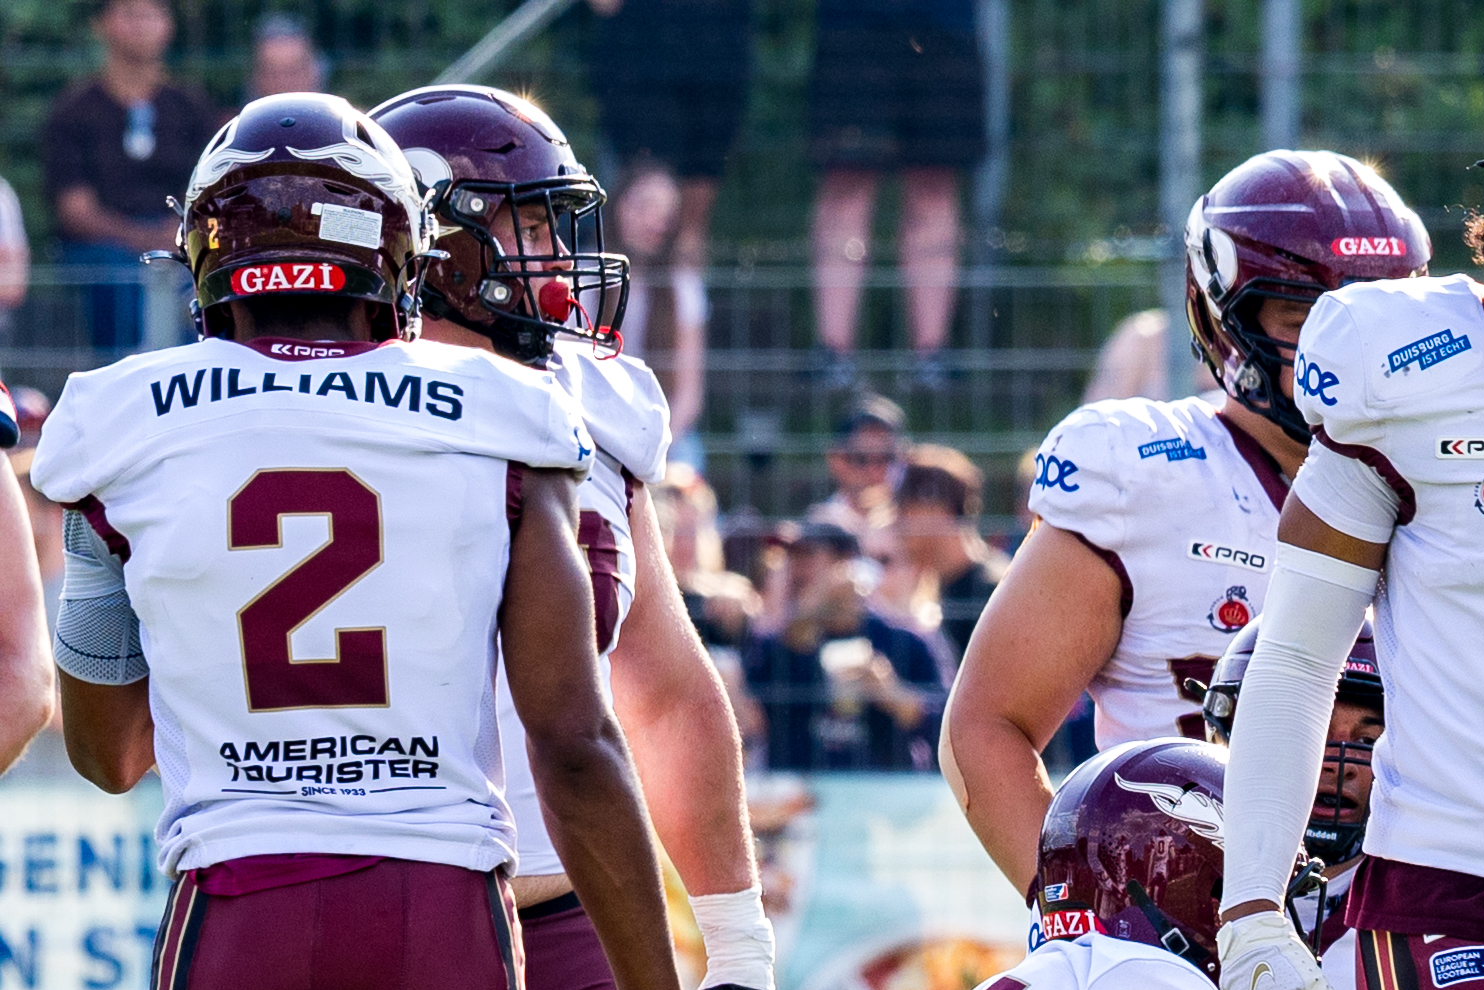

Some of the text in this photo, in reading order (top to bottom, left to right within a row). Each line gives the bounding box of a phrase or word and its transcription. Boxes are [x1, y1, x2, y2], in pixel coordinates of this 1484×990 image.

[208, 217, 220, 249] 2
[1391, 333, 1450, 367] DUISBURG
[1421, 339, 1466, 365] IST ECHT
[150, 367, 465, 421] WILLIAMS
[227, 467, 391, 713] 2
[219, 734, 440, 762] AMERICAN
[301, 786, 367, 797] SINCE 1933
[1435, 951, 1480, 966] EUROPEAN
[1436, 961, 1467, 973] LEAGUE
[1437, 967, 1480, 980] FOOTBALL
